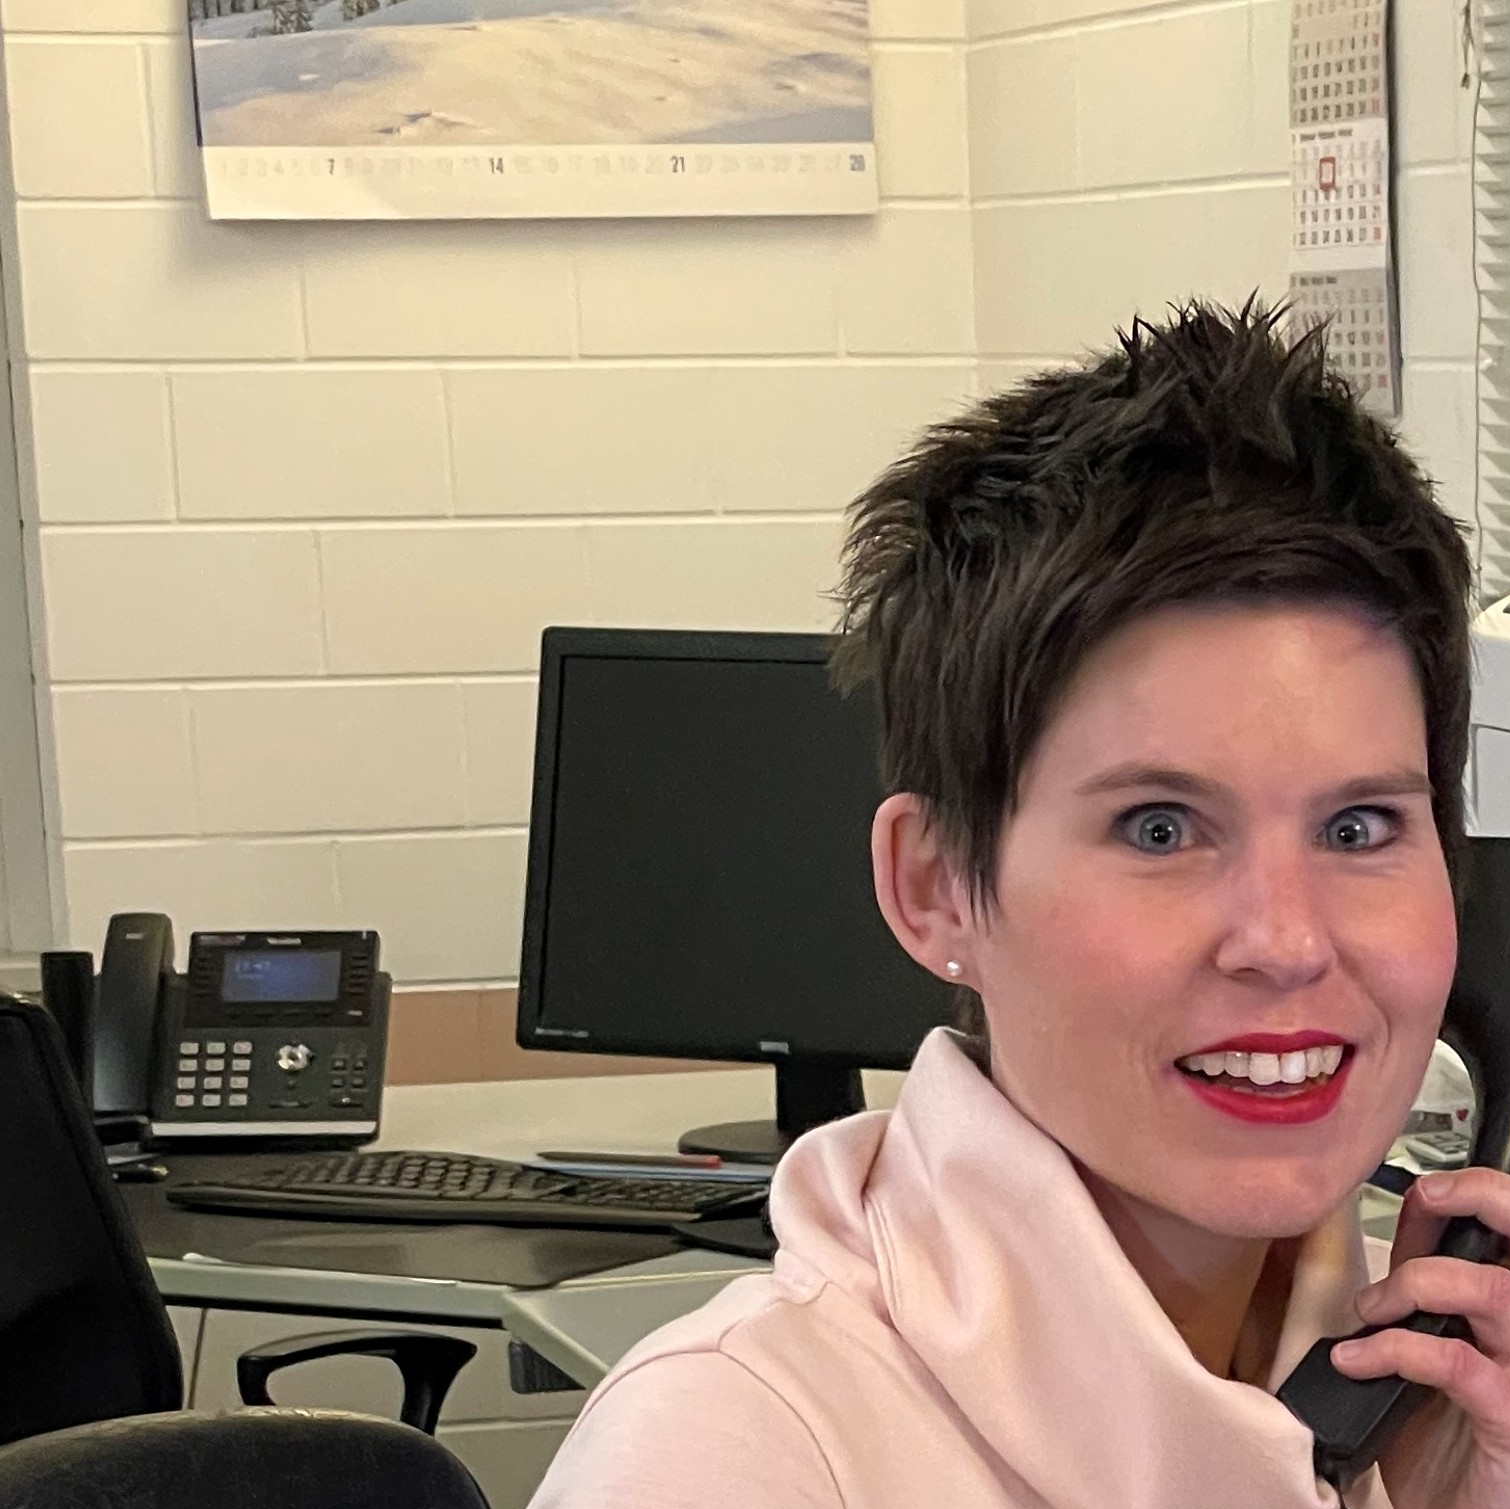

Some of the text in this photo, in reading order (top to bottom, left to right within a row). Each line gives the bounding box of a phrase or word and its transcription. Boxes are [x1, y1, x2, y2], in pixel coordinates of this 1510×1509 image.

[328, 158, 335, 175] 7
[489, 157, 504, 175] 14
[670, 155, 686, 173] 21
